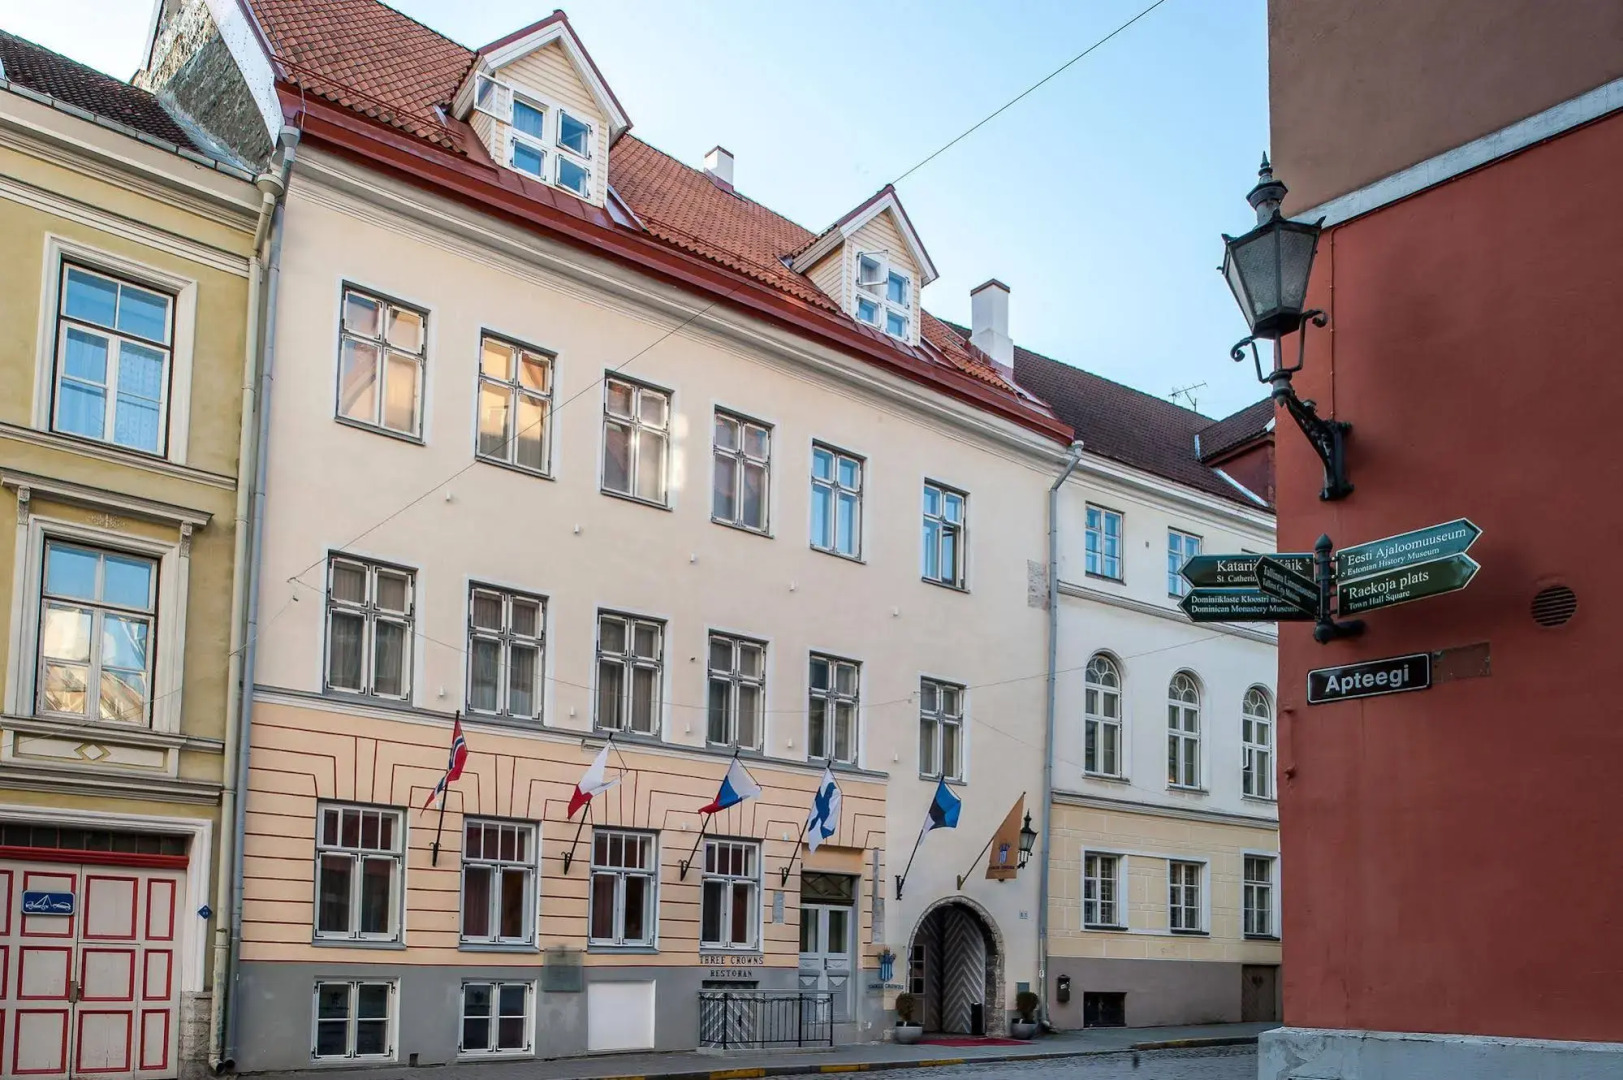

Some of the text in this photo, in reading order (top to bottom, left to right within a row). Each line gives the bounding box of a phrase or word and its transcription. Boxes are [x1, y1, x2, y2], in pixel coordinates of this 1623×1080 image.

[1347, 528, 1466, 566] Eesti Ajaloomuuseum
[1347, 547, 1440, 576] Estonian History Museum
[1349, 571, 1429, 600] Raekoja plats
[1191, 605, 1230, 613] Dominican
[1230, 605, 1267, 614] Monastery
[1348, 589, 1410, 611] Town Hall Square
[1325, 664, 1409, 695] Apteegi
[700, 955, 764, 965] THREE CROWNS
[710, 970, 753, 978] RESTORAN
